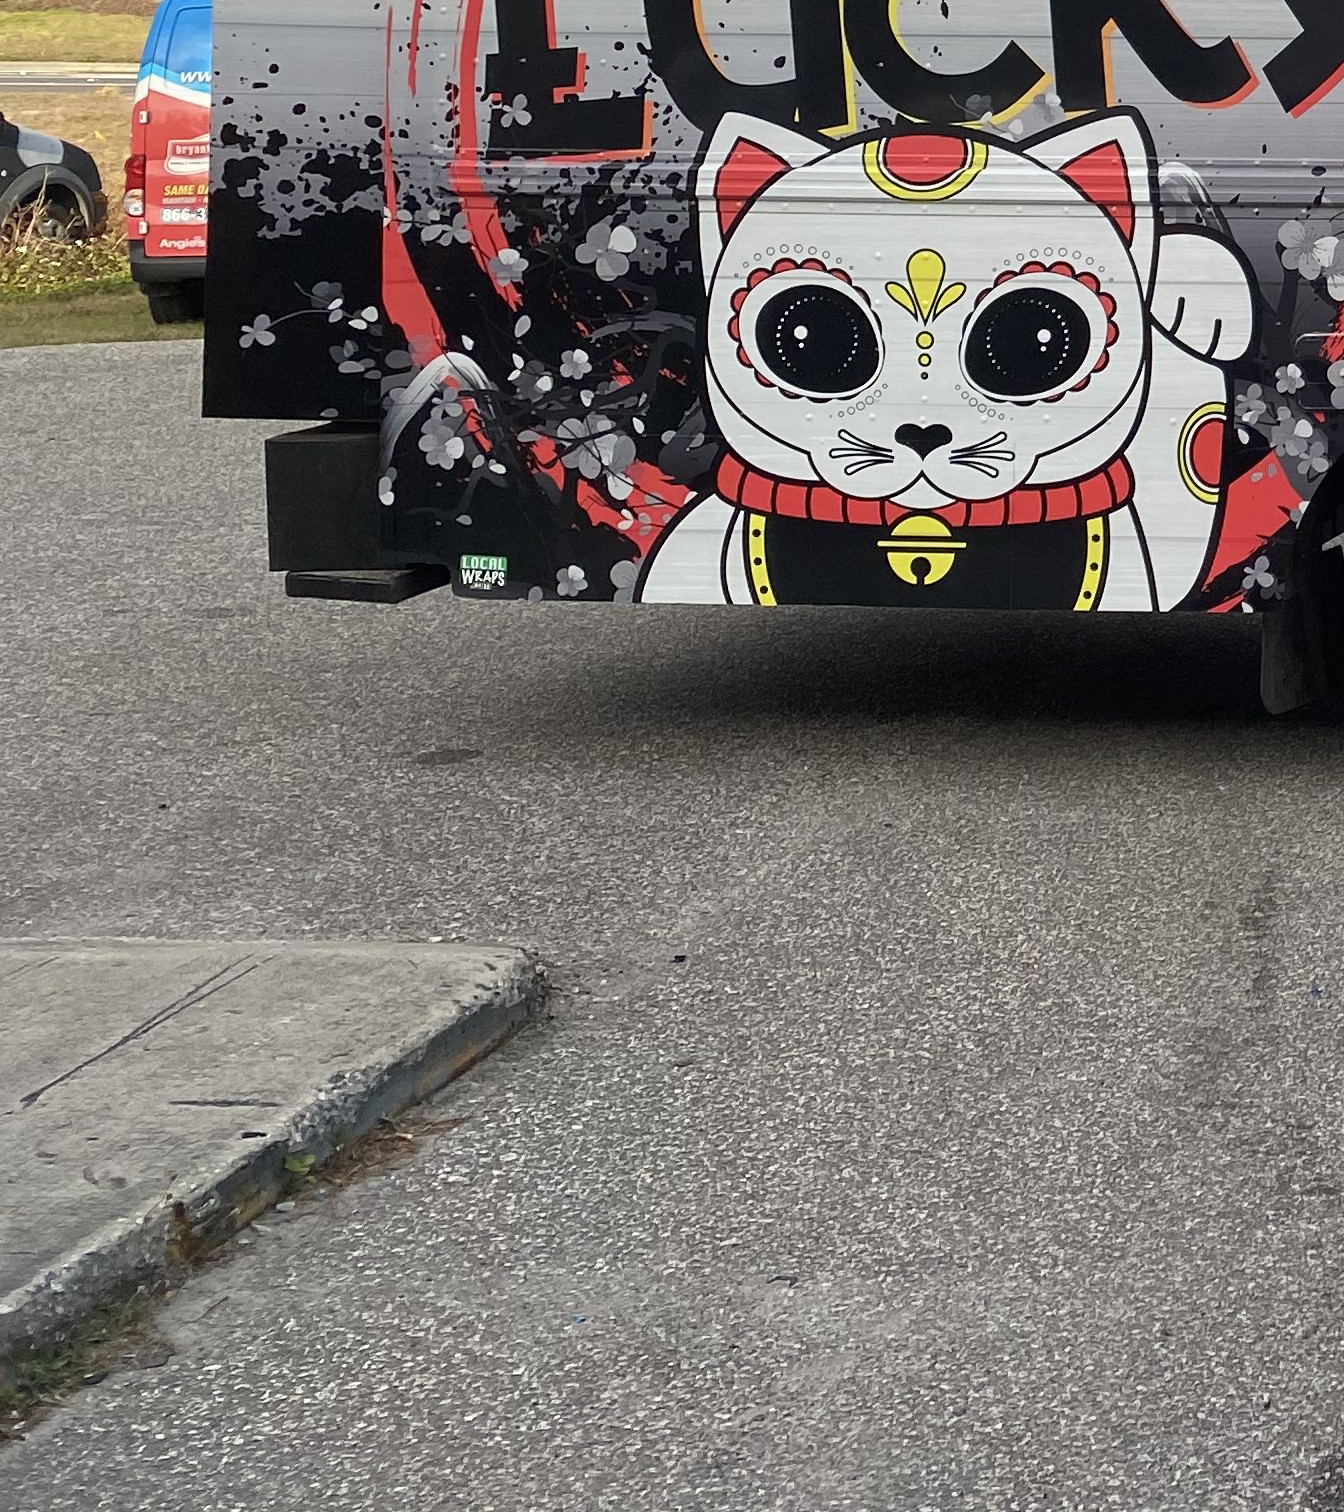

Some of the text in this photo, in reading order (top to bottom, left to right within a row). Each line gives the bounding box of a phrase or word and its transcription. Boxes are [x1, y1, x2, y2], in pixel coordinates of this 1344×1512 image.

[163, 184, 195, 197] SAME
[162, 207, 208, 222] 866-3
[462, 555, 505, 571] LOCAL
[461, 569, 505, 587] WRAPS
